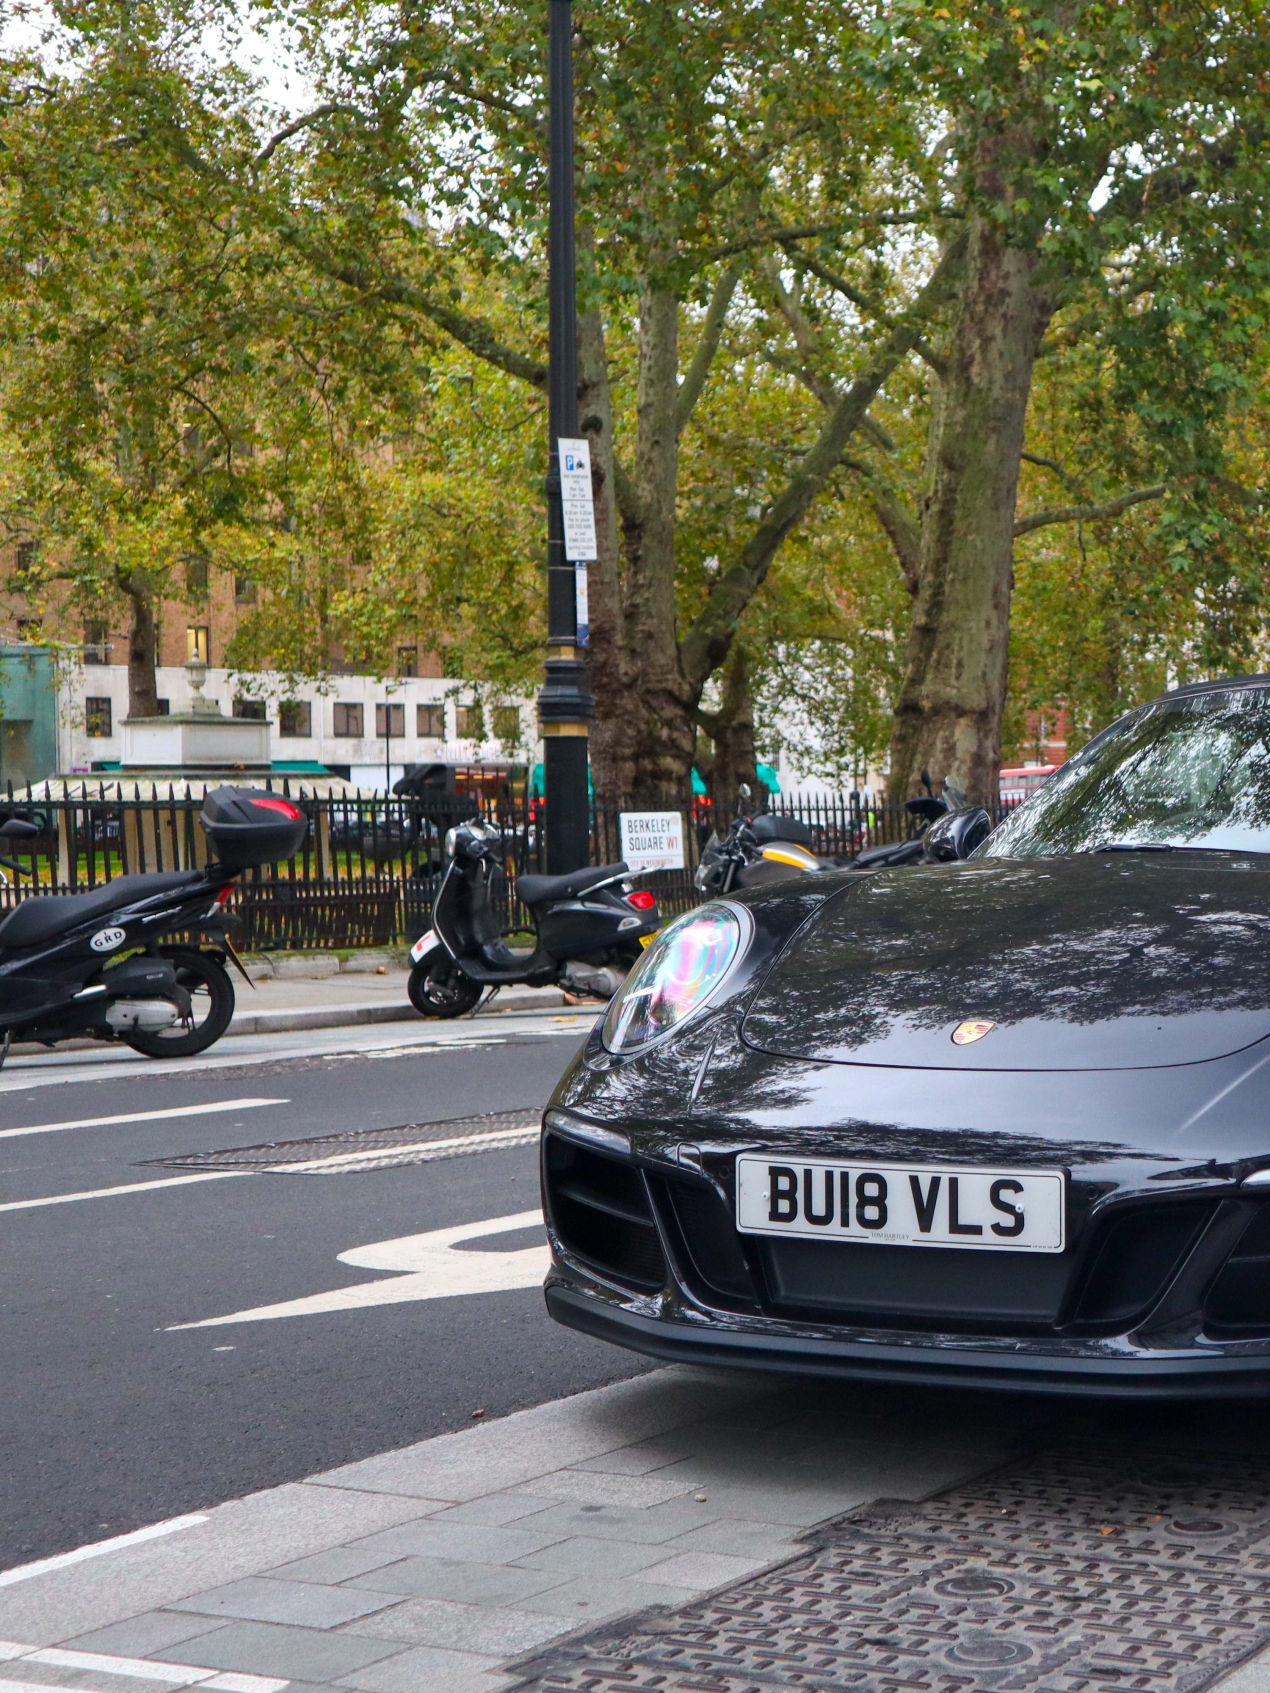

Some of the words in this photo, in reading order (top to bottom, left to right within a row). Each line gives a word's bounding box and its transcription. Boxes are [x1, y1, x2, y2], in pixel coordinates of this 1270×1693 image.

[627, 818, 671, 834] BERKELEY
[628, 836, 664, 851] SQUARE
[666, 836, 678, 850] W1
[768, 1165, 889, 1231] BU18
[908, 1175, 1026, 1238] VLS
